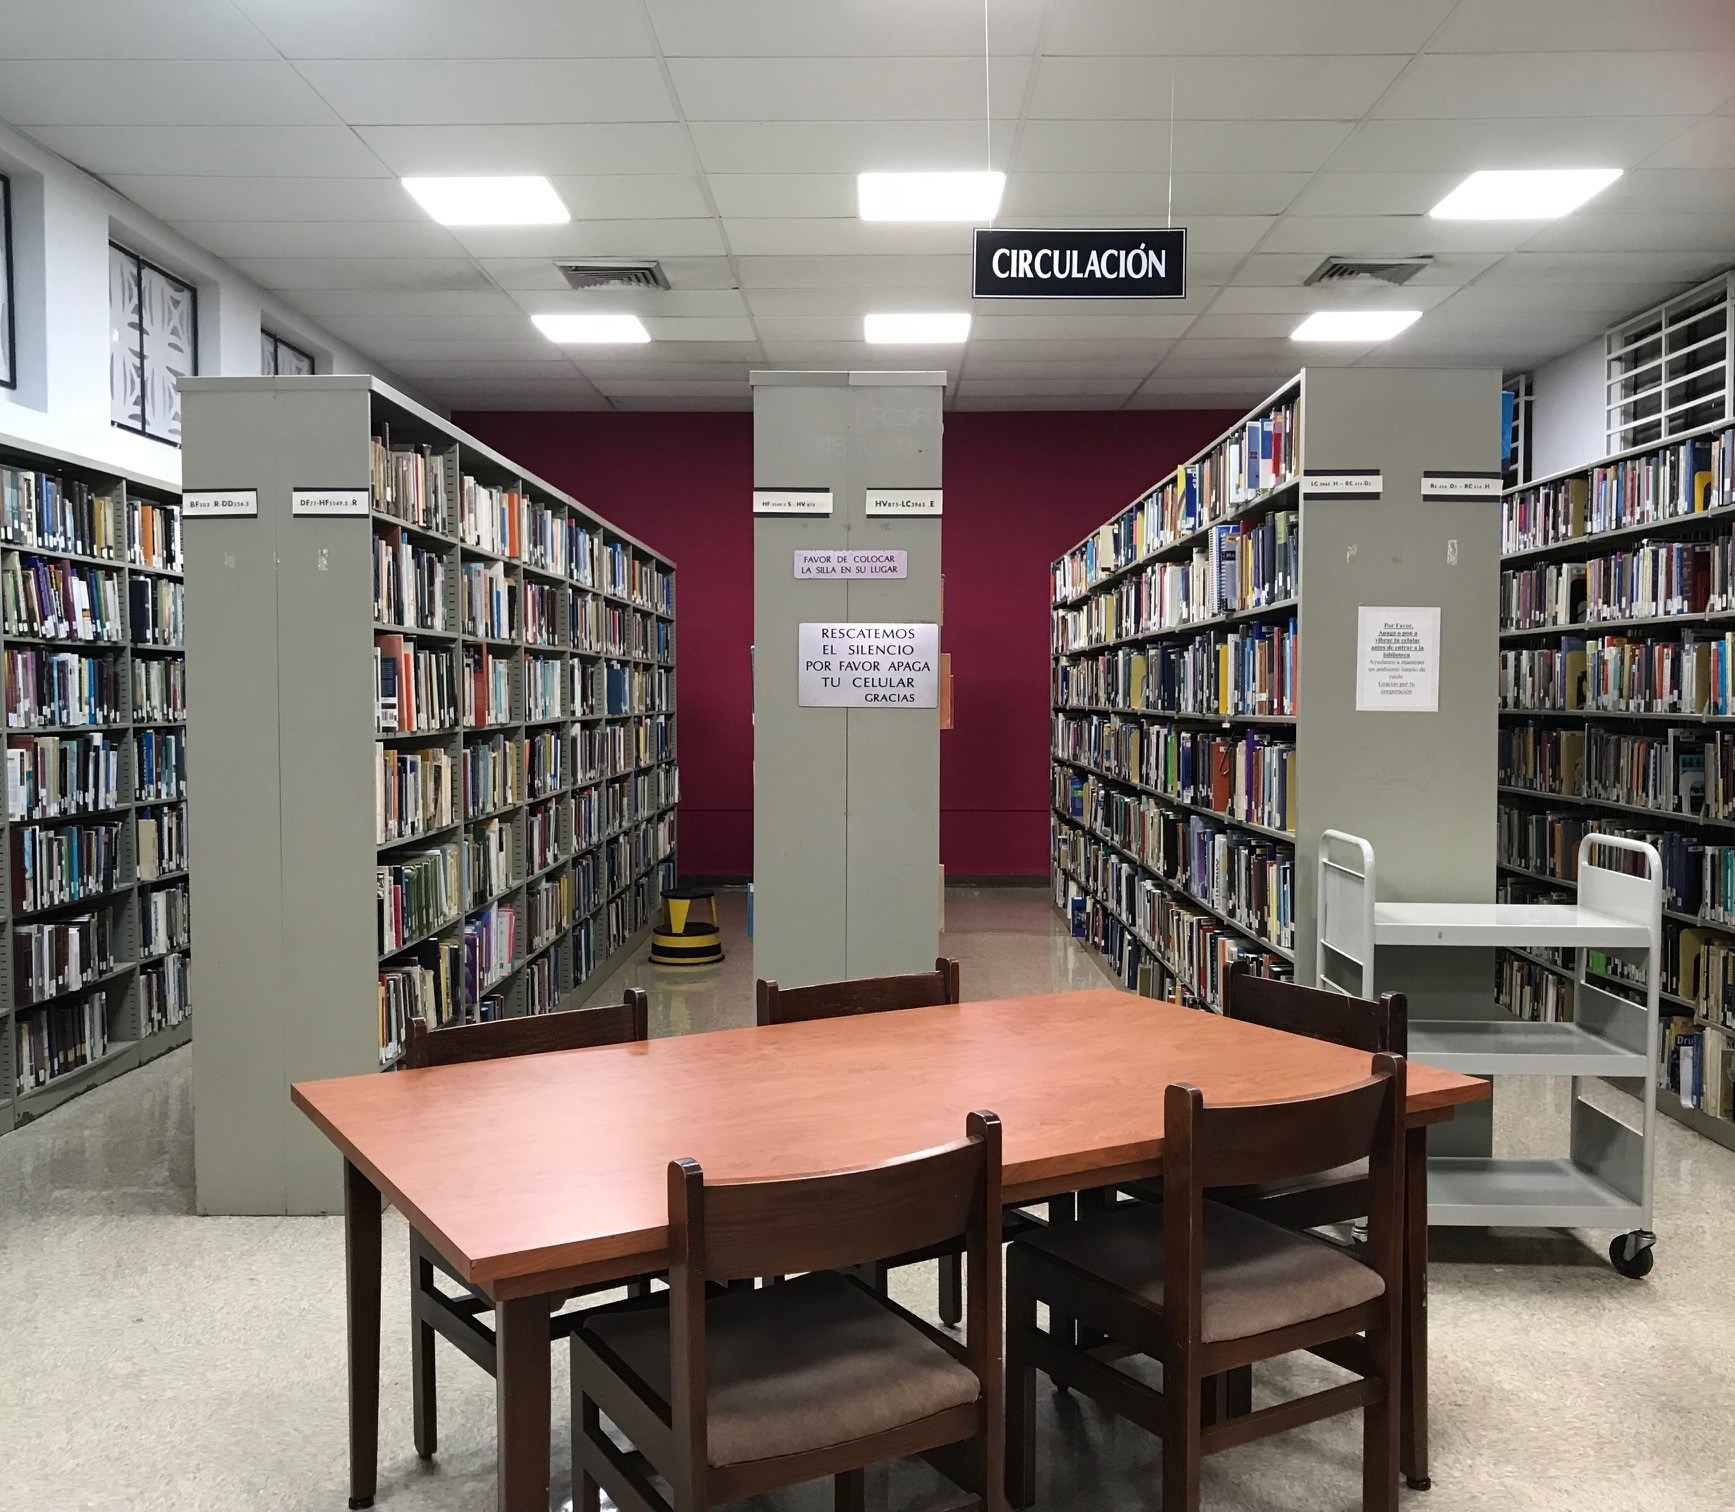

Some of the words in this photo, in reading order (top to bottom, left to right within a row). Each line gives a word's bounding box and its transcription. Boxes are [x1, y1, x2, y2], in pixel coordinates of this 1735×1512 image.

[992, 243, 1166, 279] CIRCULACIÓN
[822, 628, 915, 639] RESCATEMOS
[822, 645, 837, 655] EL
[848, 645, 914, 655] SILENCIO
[806, 661, 832, 671] POR
[839, 661, 880, 671] FAVOR
[888, 661, 930, 672] APAGA
[821, 678, 841, 688] TU
[852, 677, 915, 688] CELULAR
[864, 693, 915, 702] GRACIAS
